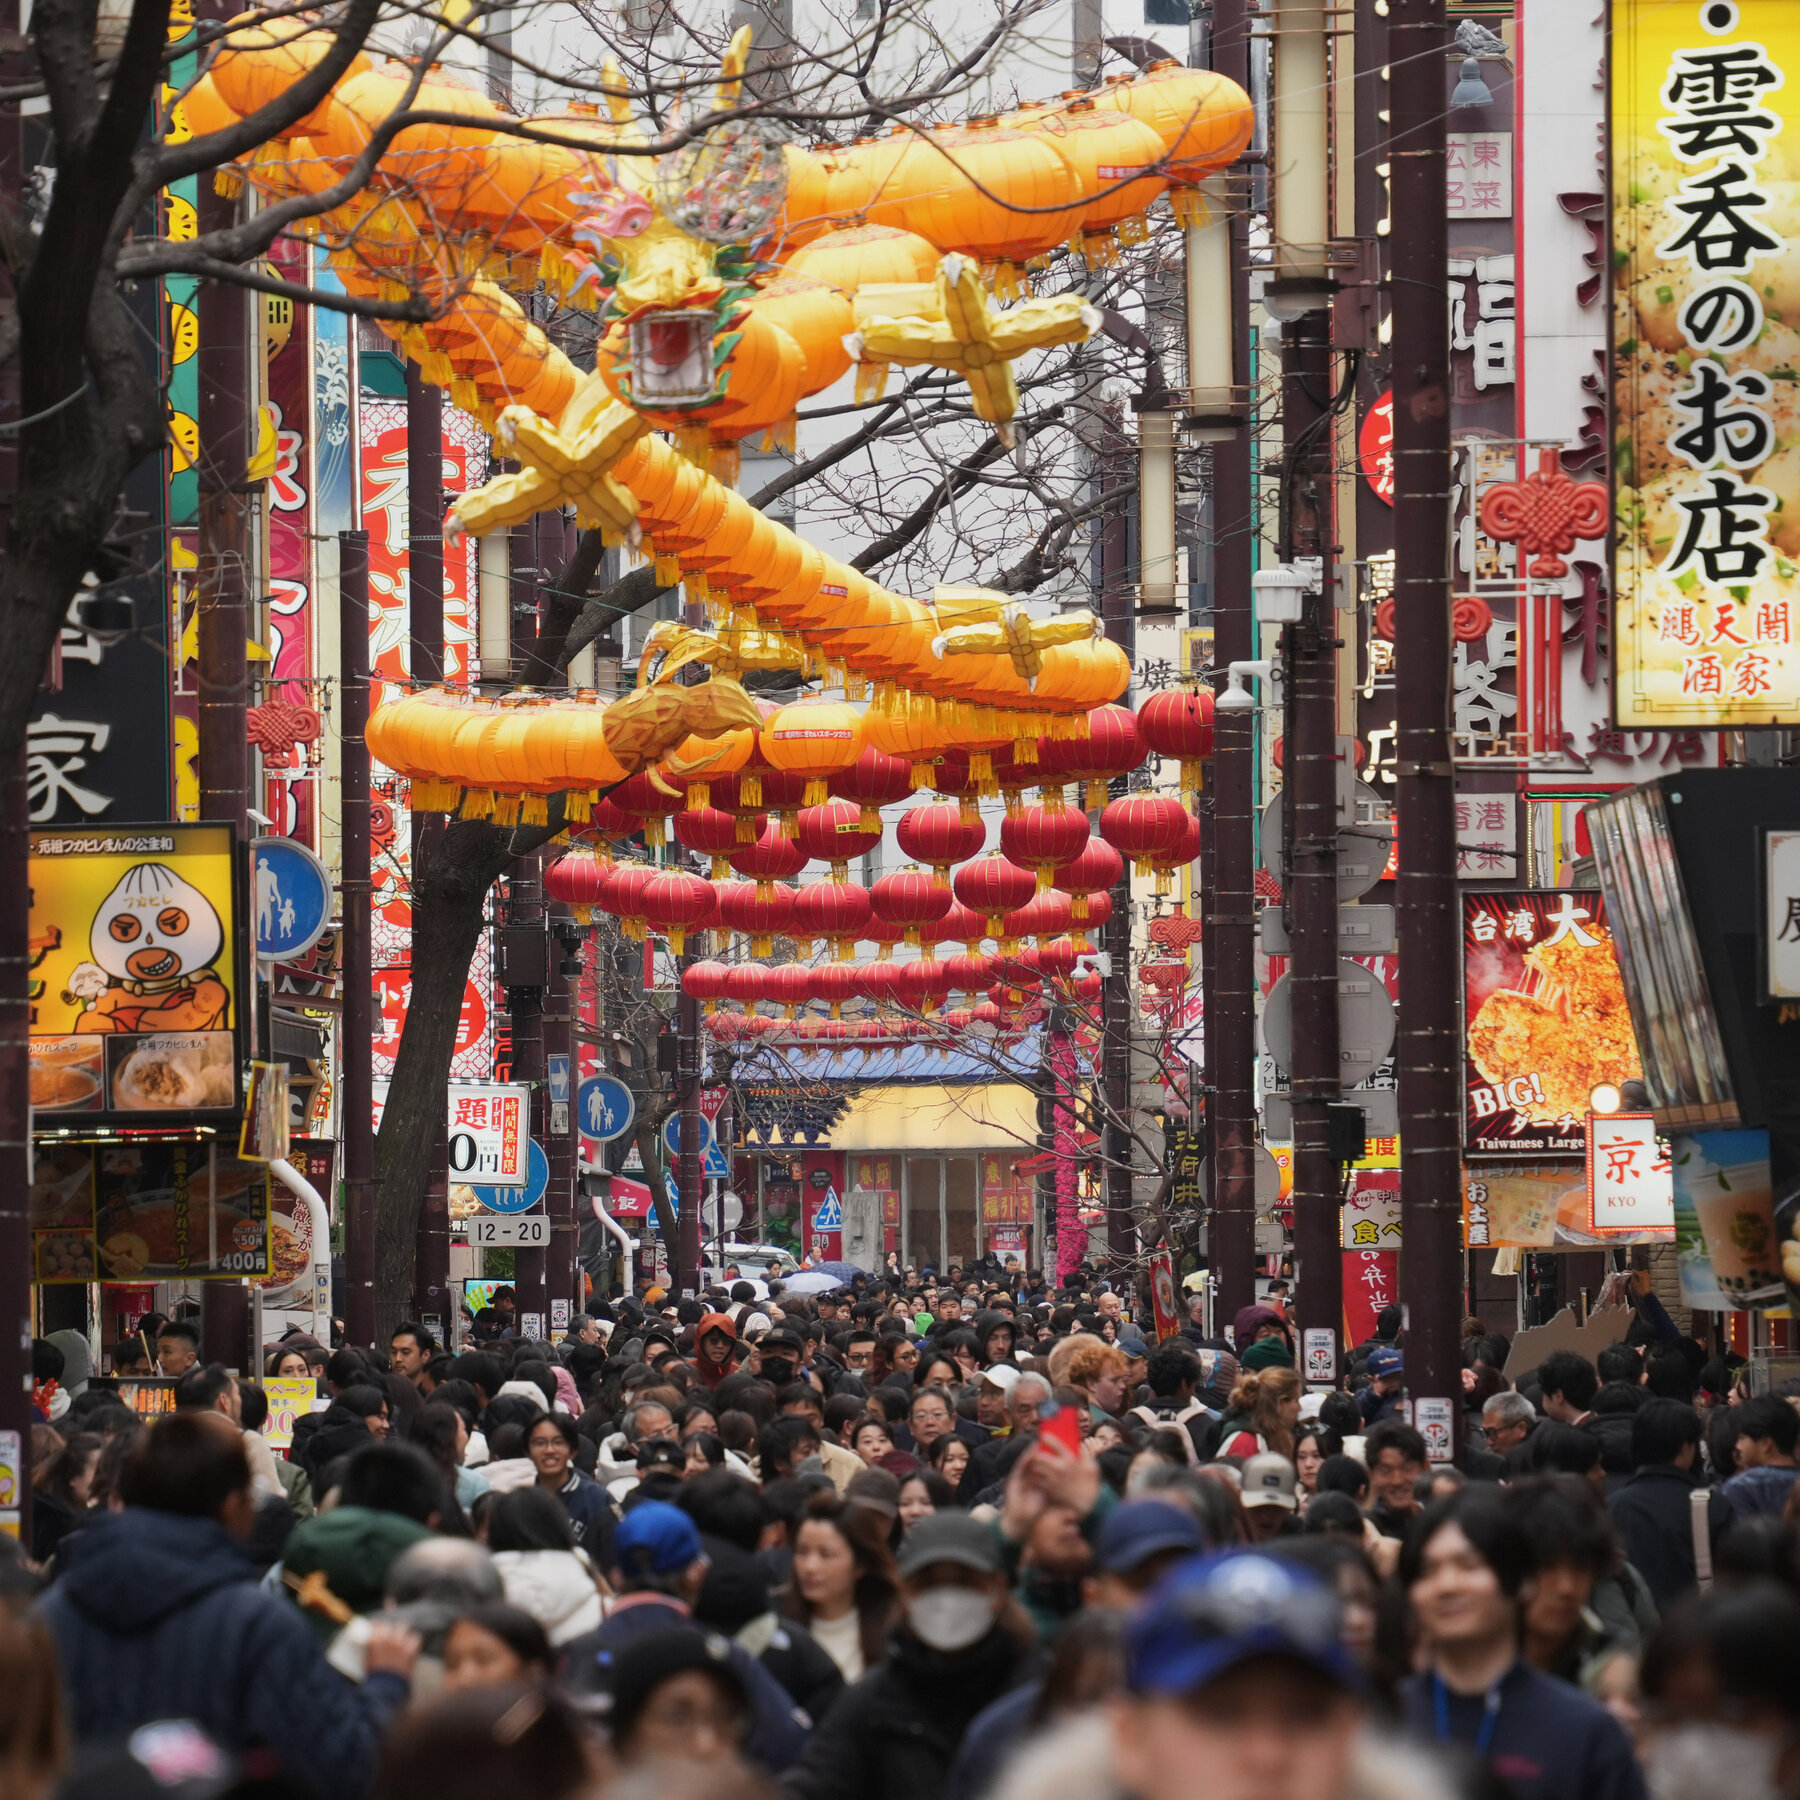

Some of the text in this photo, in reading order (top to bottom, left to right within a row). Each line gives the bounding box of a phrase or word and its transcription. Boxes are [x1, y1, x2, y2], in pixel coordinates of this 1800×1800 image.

[1683, 653, 1771, 696] 酒家
[1471, 894, 1613, 947] 台湾大
[1471, 1073, 1545, 1118] BIG!
[503, 1100, 519, 1173] 時間無制限
[1510, 1112, 1586, 1136] ダーチ
[1477, 1136, 1586, 1150] Taiwanese Large
[611, 1195, 639, 1211] 記
[1467, 1182, 1490, 1245] お土産
[1607, 1197, 1636, 1208] KYO
[221, 1252, 267, 1272] 400円
